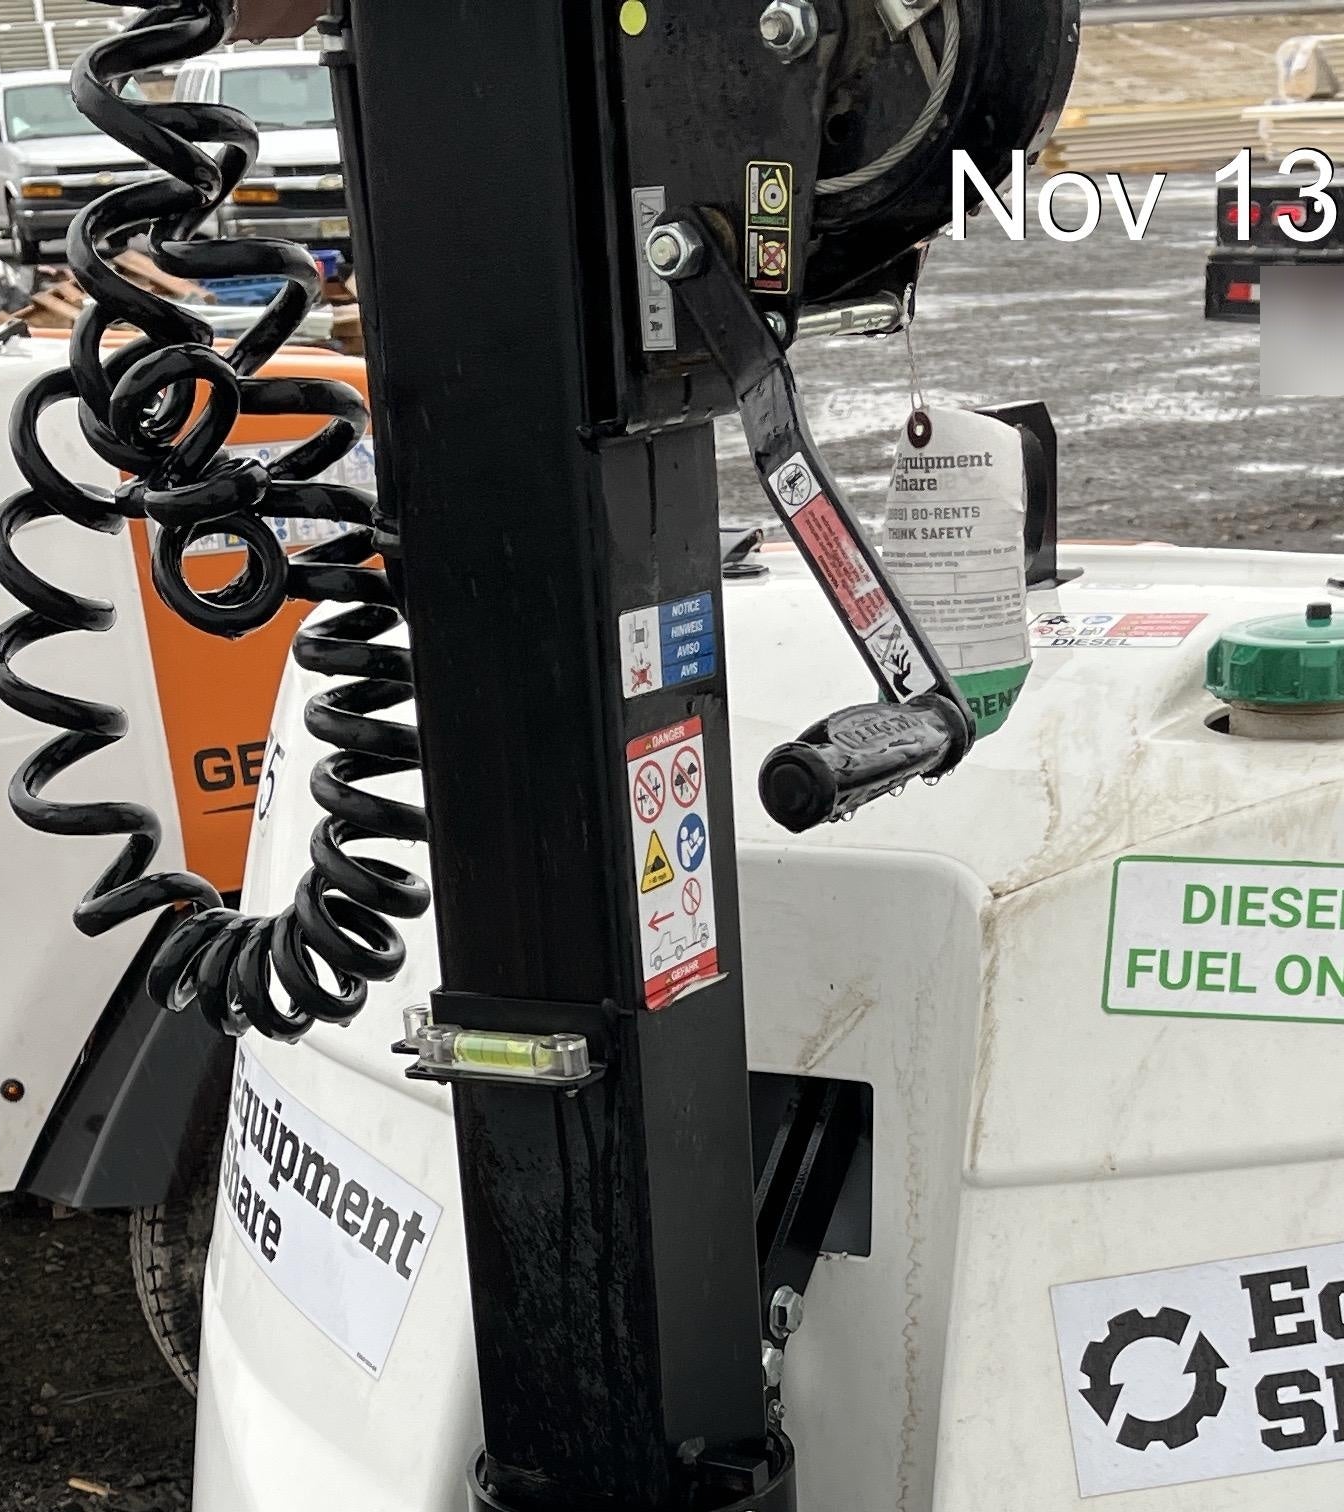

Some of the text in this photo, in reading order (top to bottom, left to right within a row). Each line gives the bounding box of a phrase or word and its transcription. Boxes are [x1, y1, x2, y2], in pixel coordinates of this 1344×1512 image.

[921, 526, 974, 540] SAFETY
[671, 600, 701, 617] NOTICE
[676, 641, 701, 659] AVISO
[1050, 638, 1132, 647] DIESEL
[680, 662, 699, 679] AVIS
[651, 725, 686, 749] DANGER
[1126, 948, 1257, 994] FUEL
[227, 1049, 427, 1281] Equipment
[220, 1122, 283, 1264] Share
